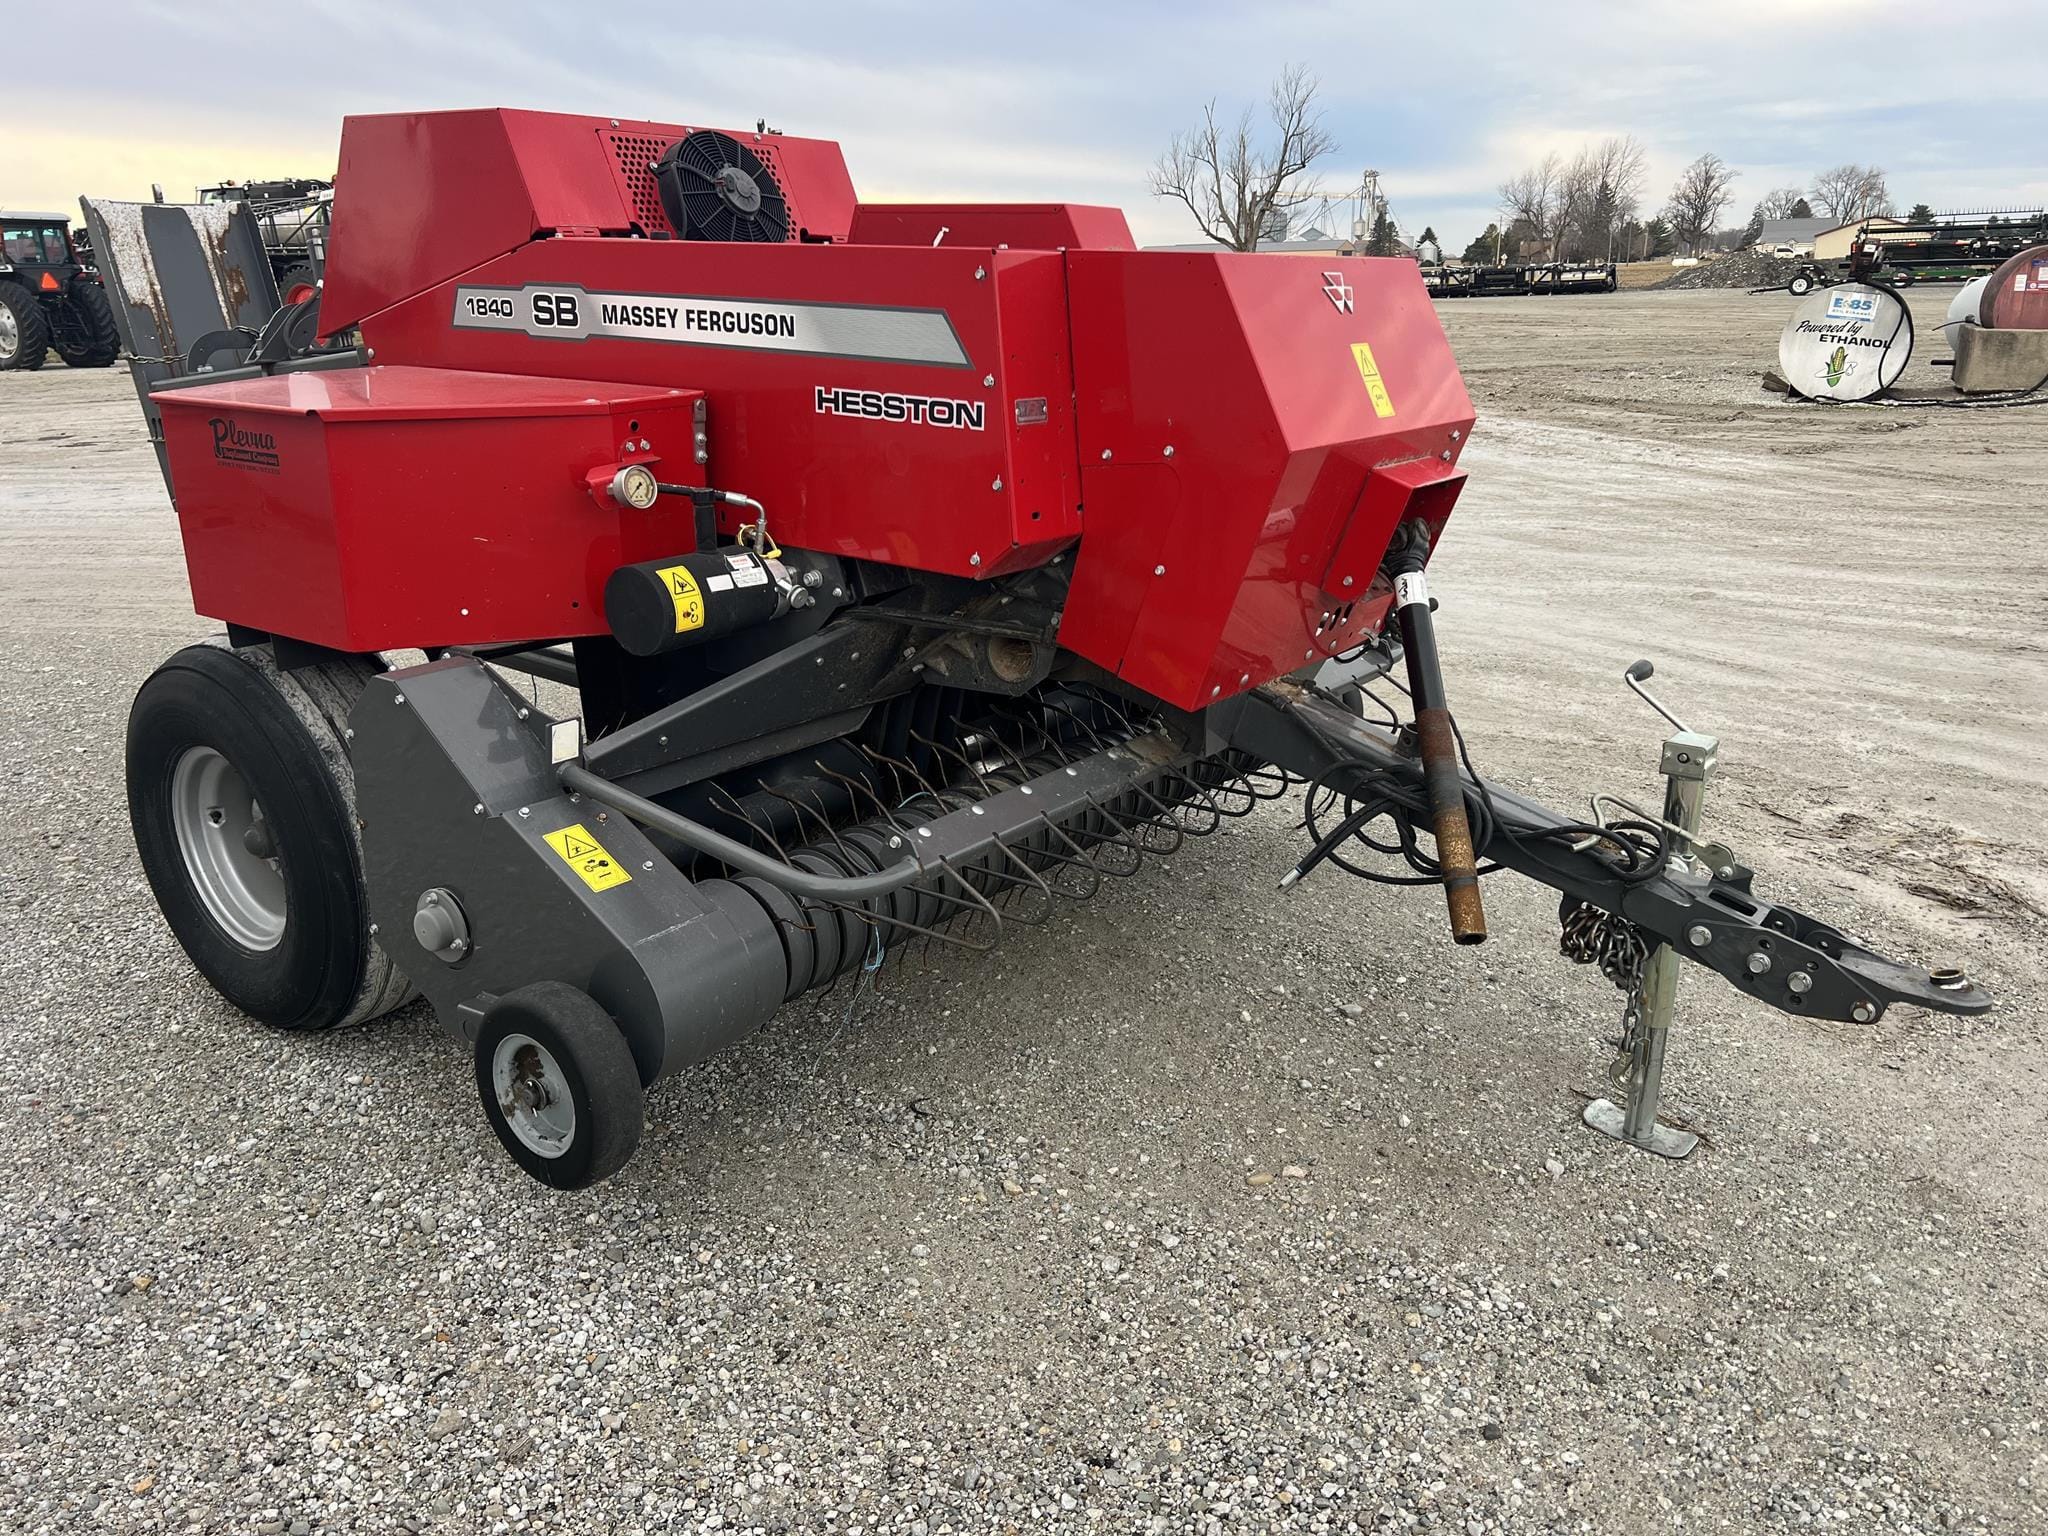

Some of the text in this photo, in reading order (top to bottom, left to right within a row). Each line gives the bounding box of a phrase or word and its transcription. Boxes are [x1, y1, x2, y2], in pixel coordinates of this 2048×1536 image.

[466, 293, 796, 338] 1840 SB MASSEY FERGUSON
[1795, 319, 1863, 337] Powered by
[814, 387, 985, 430] HESSTON
